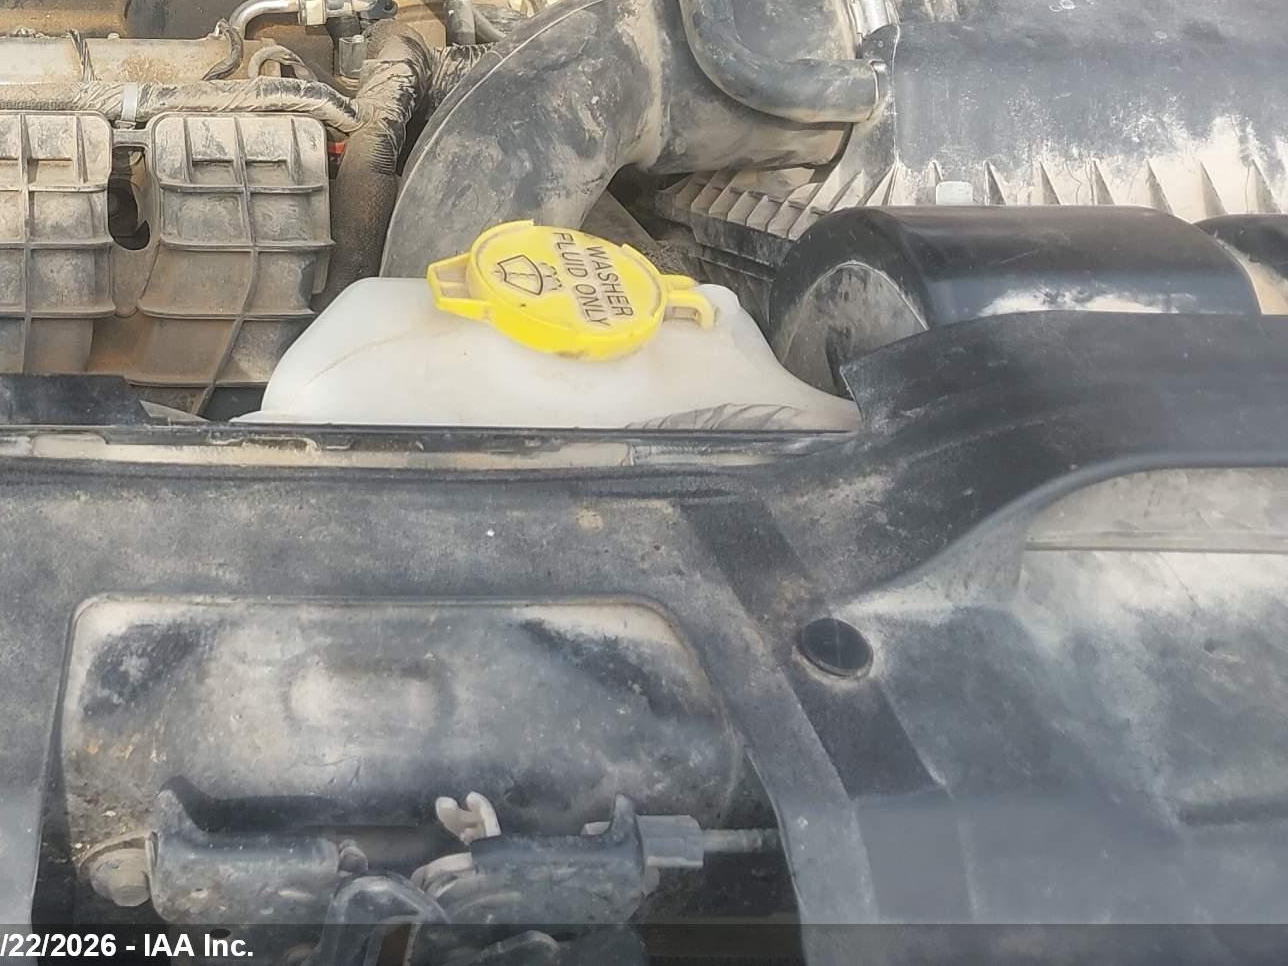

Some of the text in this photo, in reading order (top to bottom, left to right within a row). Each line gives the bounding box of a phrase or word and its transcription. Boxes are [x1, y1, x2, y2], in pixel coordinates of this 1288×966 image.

[552, 232, 611, 327] FLUID ONLY
[585, 245, 634, 318] WASHER
